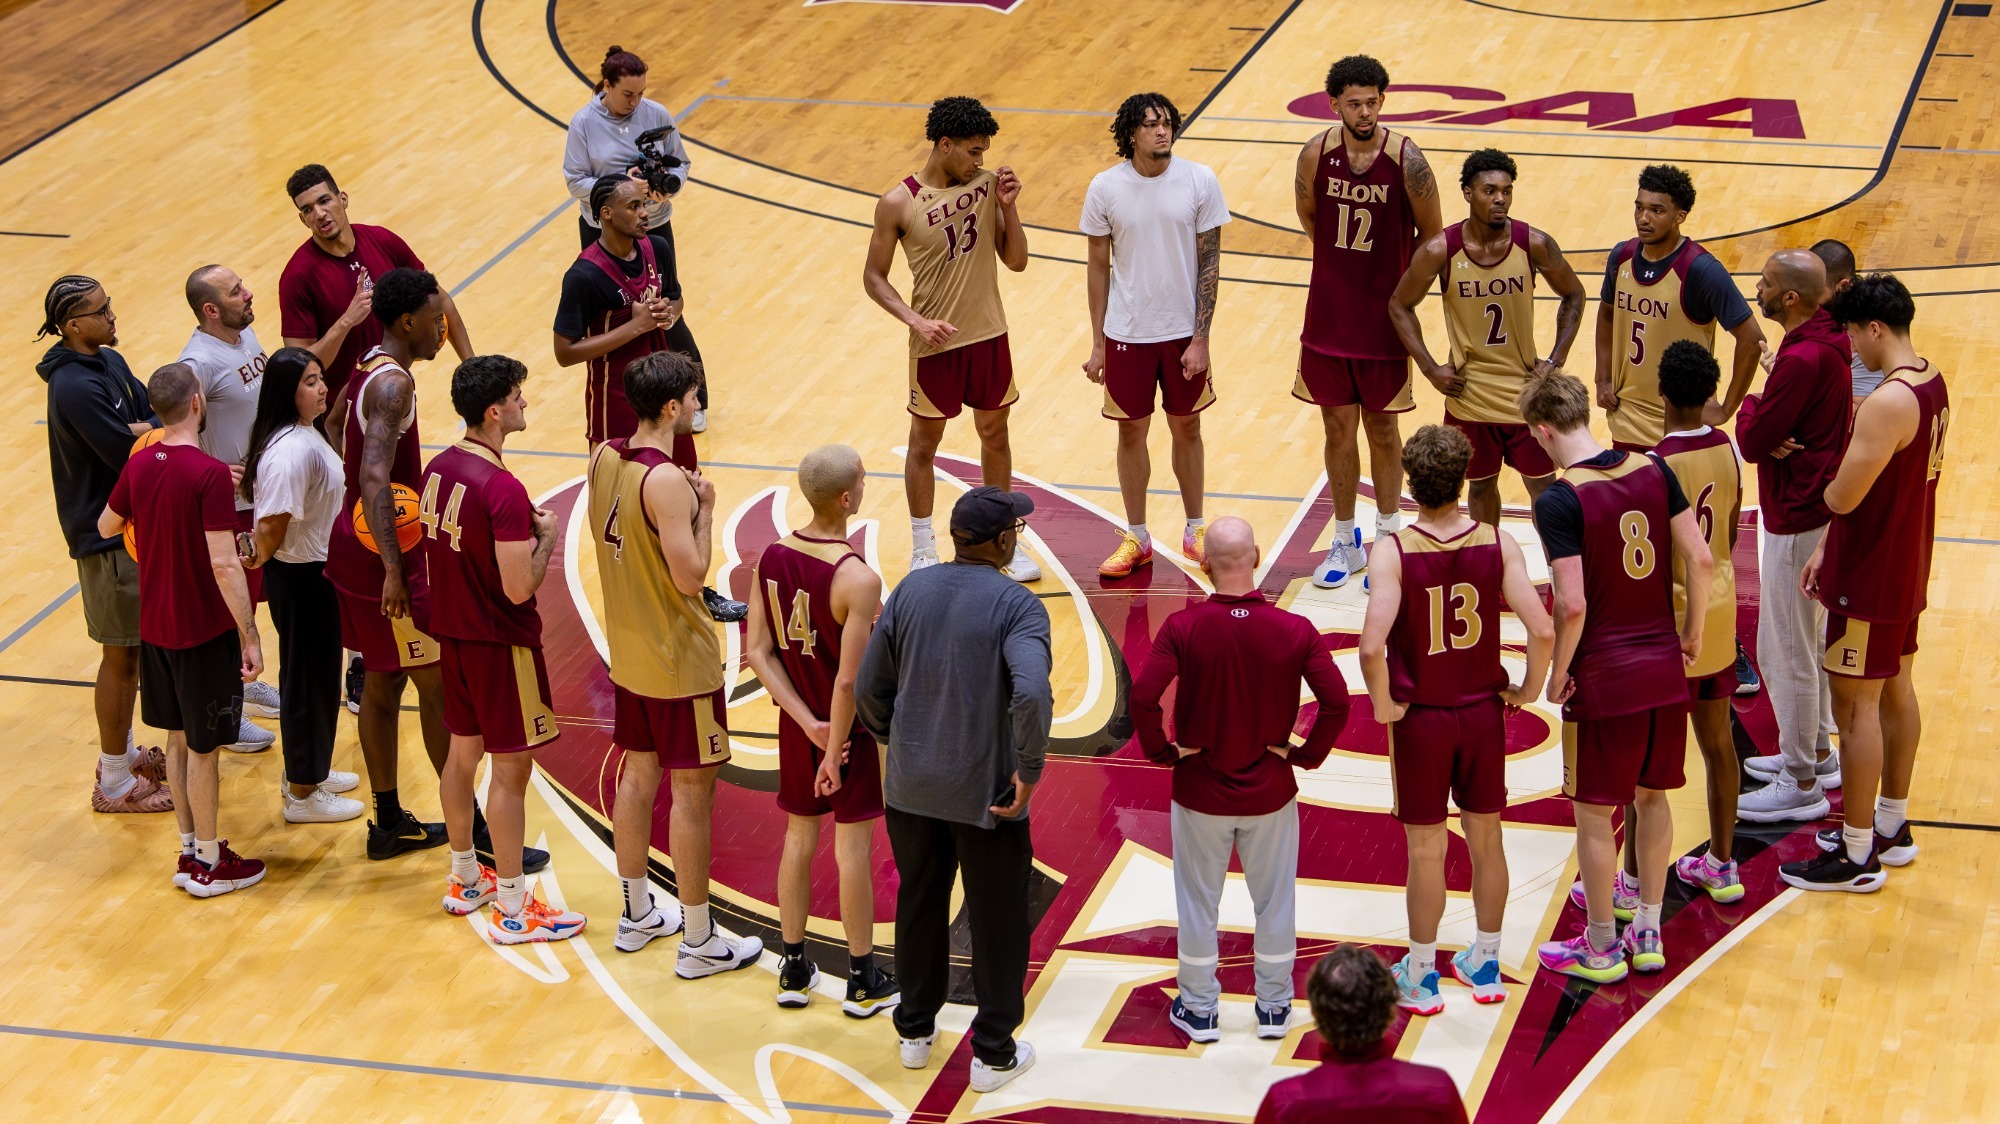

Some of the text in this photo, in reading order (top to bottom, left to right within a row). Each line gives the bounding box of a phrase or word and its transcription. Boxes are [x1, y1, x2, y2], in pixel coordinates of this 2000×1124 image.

[1287, 84, 1806, 139] CAA
[926, 181, 989, 227] ELON
[1326, 176, 1389, 203] ELON
[940, 211, 978, 264] 13
[1335, 203, 1373, 252] 12
[1457, 275, 1525, 298] ELON
[1617, 290, 1670, 320] ELON
[1484, 302, 1508, 346] 2
[1628, 319, 1647, 366] 5
[419, 472, 467, 552] 44
[604, 495, 624, 561] 4
[1695, 482, 1715, 547] 6
[1619, 510, 1656, 580] 8
[766, 579, 817, 659] 14
[1425, 582, 1483, 656] 13
[404, 640, 425, 660] E
[1839, 646, 1858, 668] E
[531, 714, 549, 737] E
[706, 733, 722, 756] E
